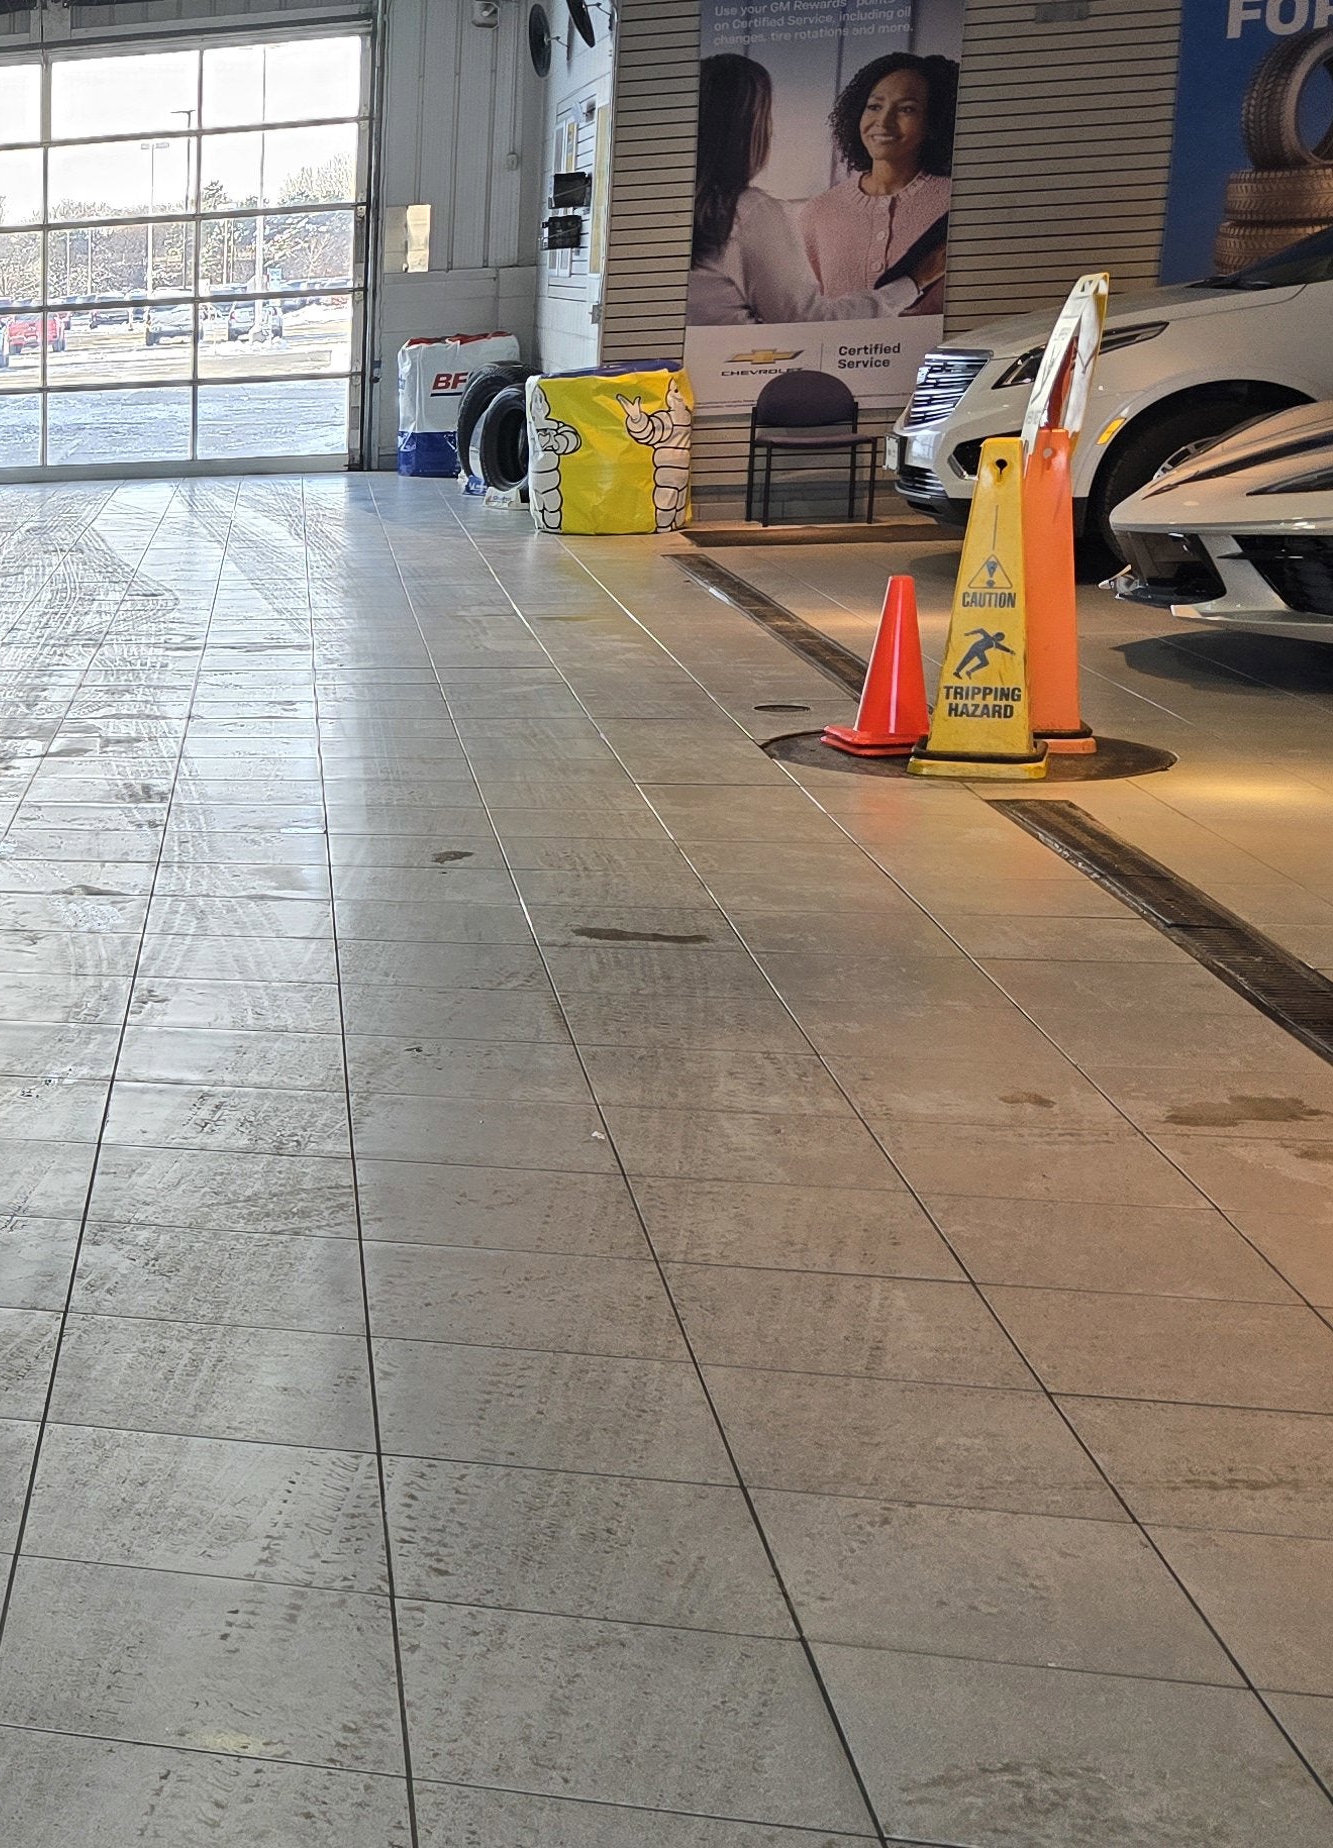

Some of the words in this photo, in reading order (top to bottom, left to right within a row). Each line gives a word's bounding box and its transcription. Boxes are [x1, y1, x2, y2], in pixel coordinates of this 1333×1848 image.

[715, 6, 738, 17] Use
[739, 6, 768, 17] your
[770, 2, 791, 13] GM
[793, 0, 847, 11] Rewards
[714, 22, 730, 32] on
[732, 17, 785, 29] Certified
[839, 8, 893, 23] including
[897, 6, 912, 18] oil
[771, 31, 792, 42] tire
[794, 26, 849, 40] rotations
[852, 25, 876, 36] and
[877, 22, 914, 34] more.
[838, 342, 901, 356] Certified
[837, 358, 891, 369] Service
[432, 371, 473, 391] BF
[961, 591, 1016, 609] CAUTION
[943, 684, 1022, 702] TRIPPING
[947, 702, 1015, 720] HAZARD
